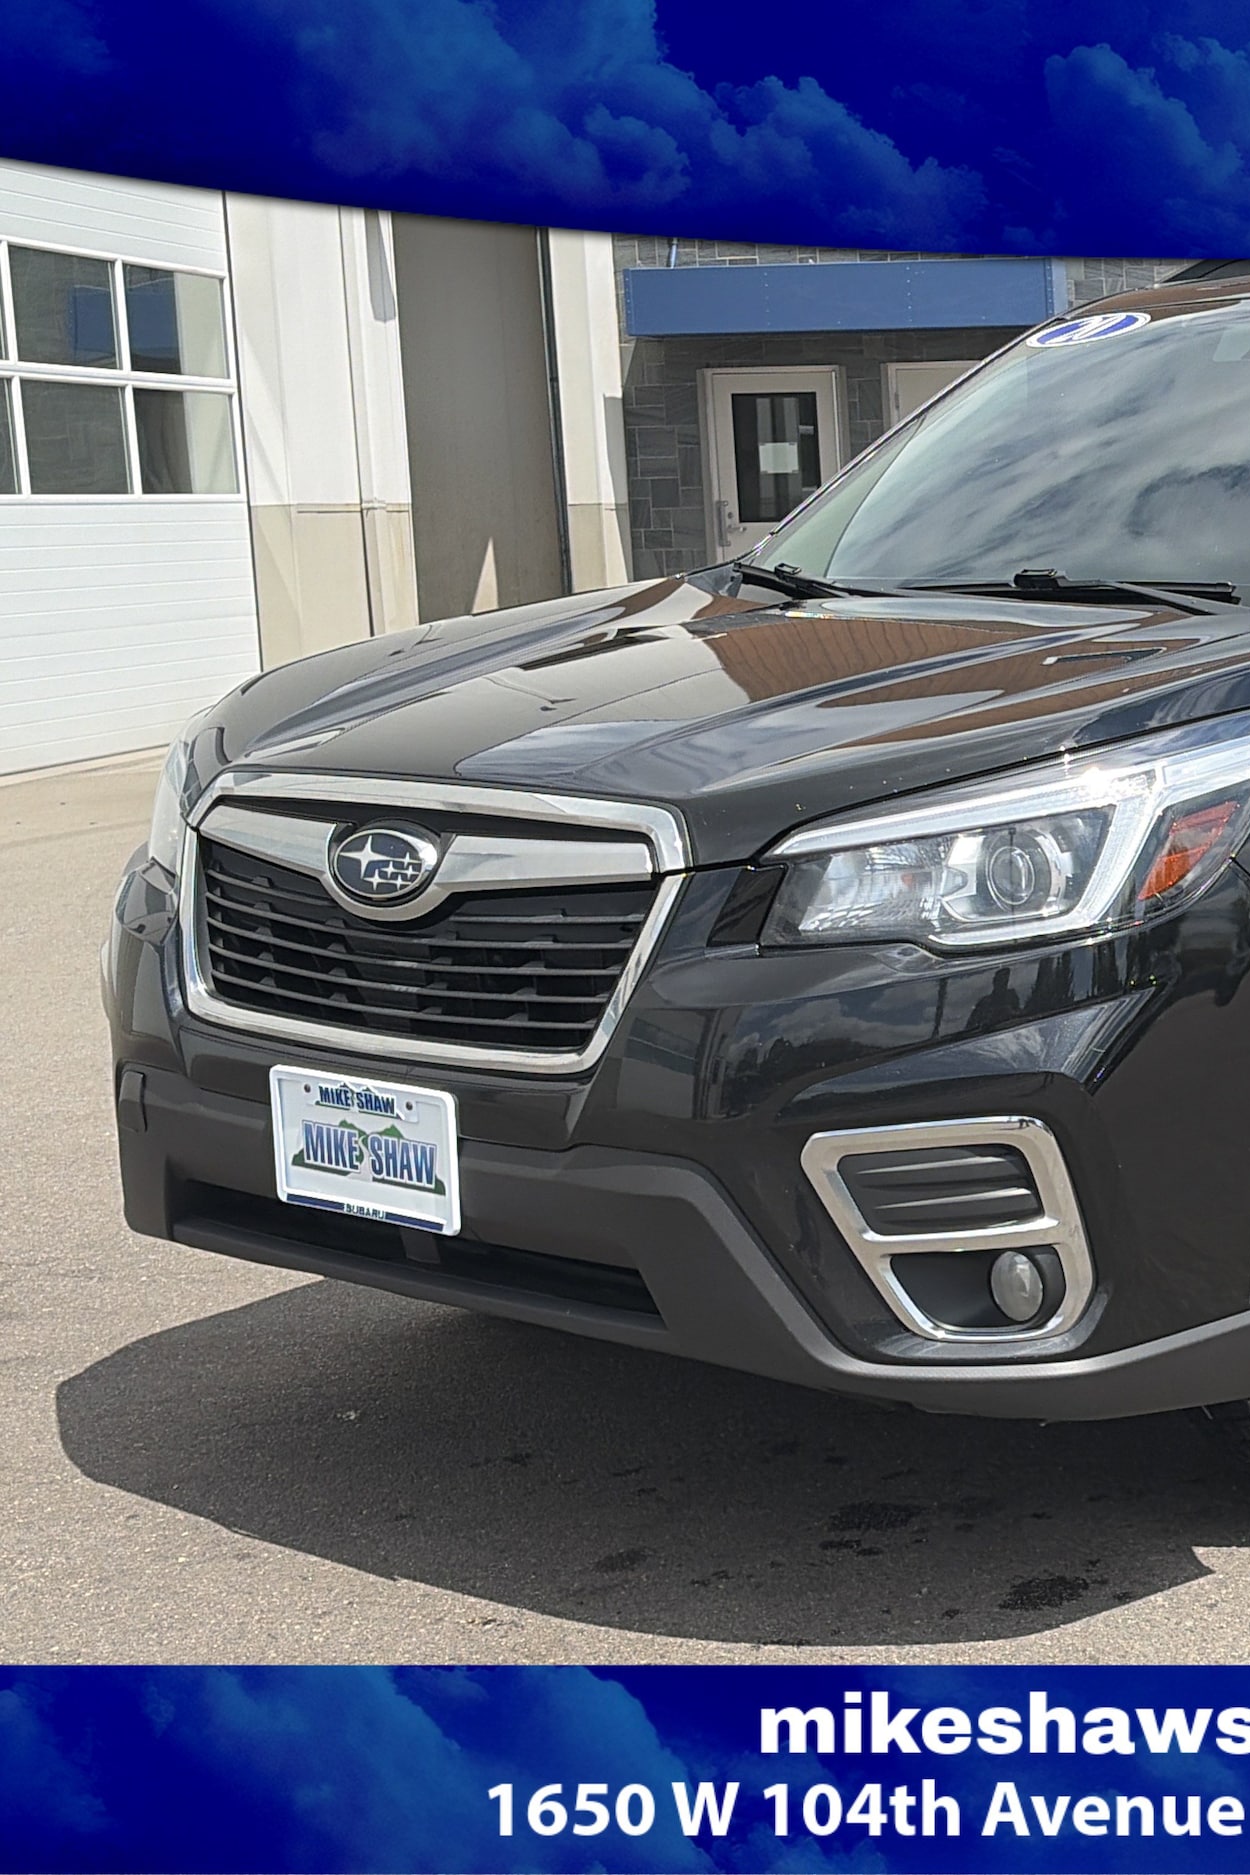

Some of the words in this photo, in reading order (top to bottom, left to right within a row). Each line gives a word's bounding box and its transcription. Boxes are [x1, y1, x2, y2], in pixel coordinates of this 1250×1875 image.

[319, 1087, 351, 1107] MIKE
[356, 1092, 395, 1115] SHAW
[303, 1123, 359, 1170] MIKE
[369, 1136, 436, 1185] SHAW
[346, 1203, 385, 1220] SUBARU
